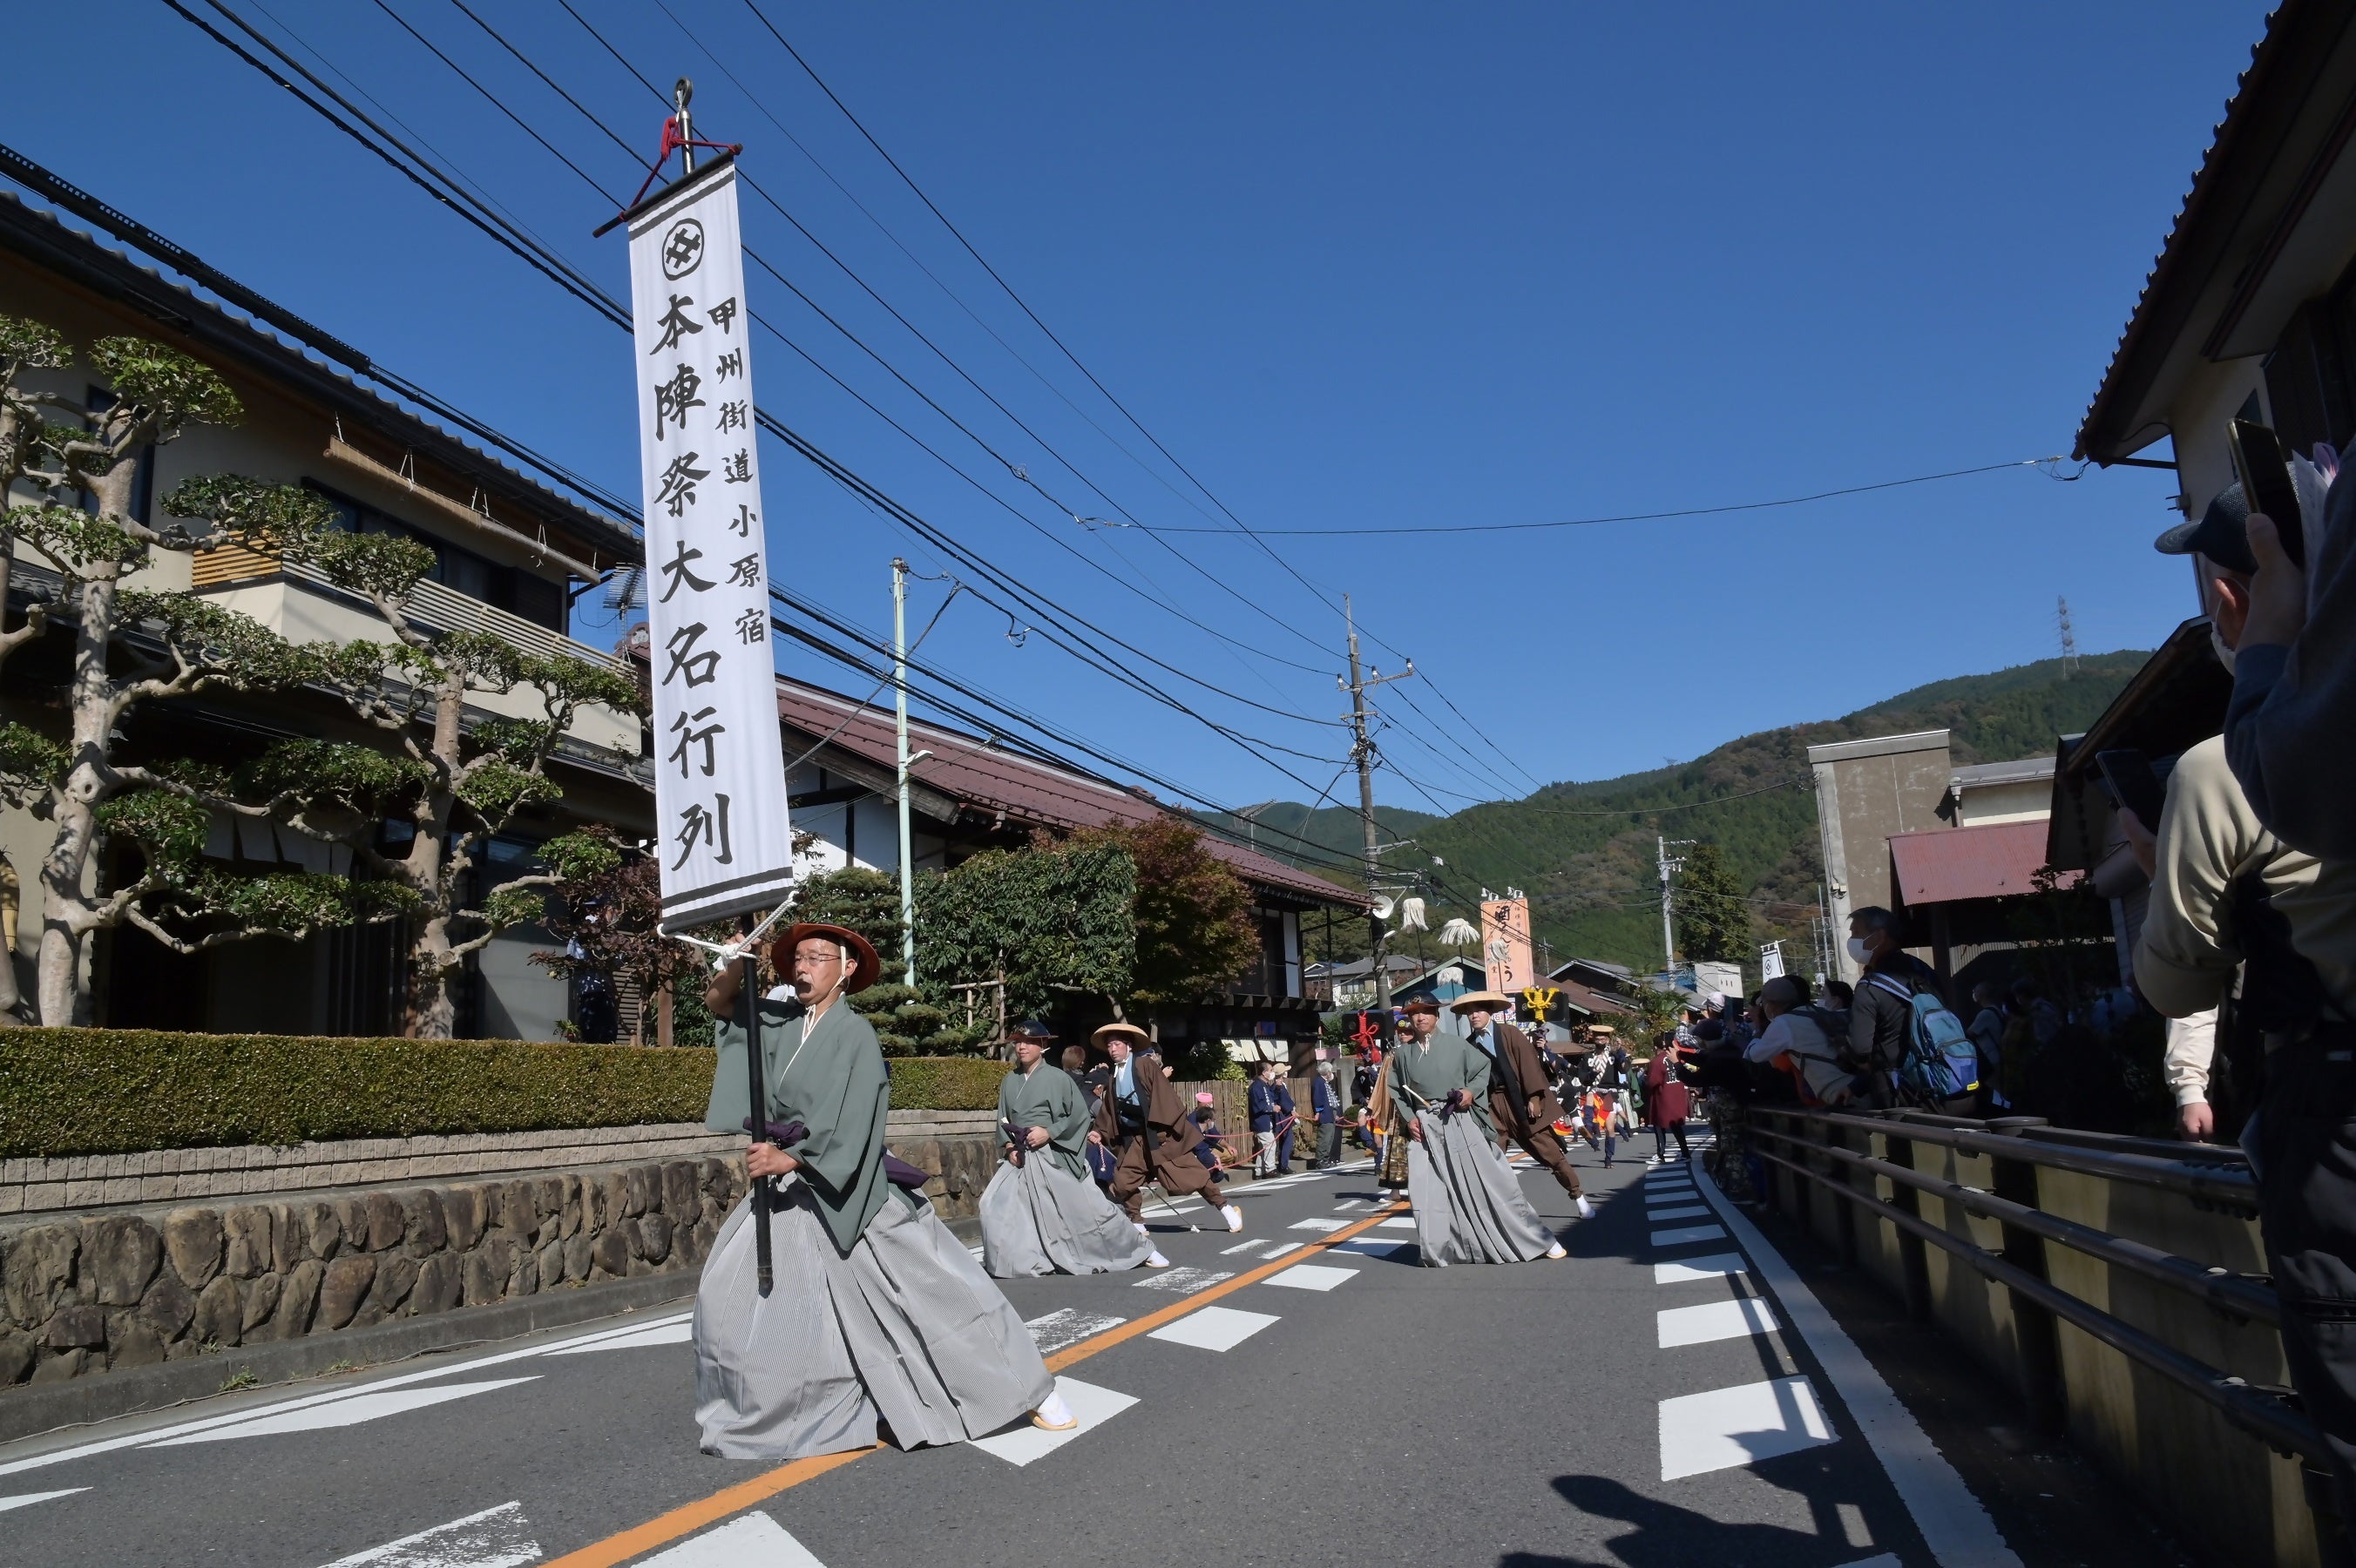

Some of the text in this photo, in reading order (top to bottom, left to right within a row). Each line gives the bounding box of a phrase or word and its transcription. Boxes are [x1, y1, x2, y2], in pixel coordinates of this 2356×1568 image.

[650, 294, 733, 871] 本陣祭大名行列
[707, 297, 765, 645] 甲州街道小原宿
